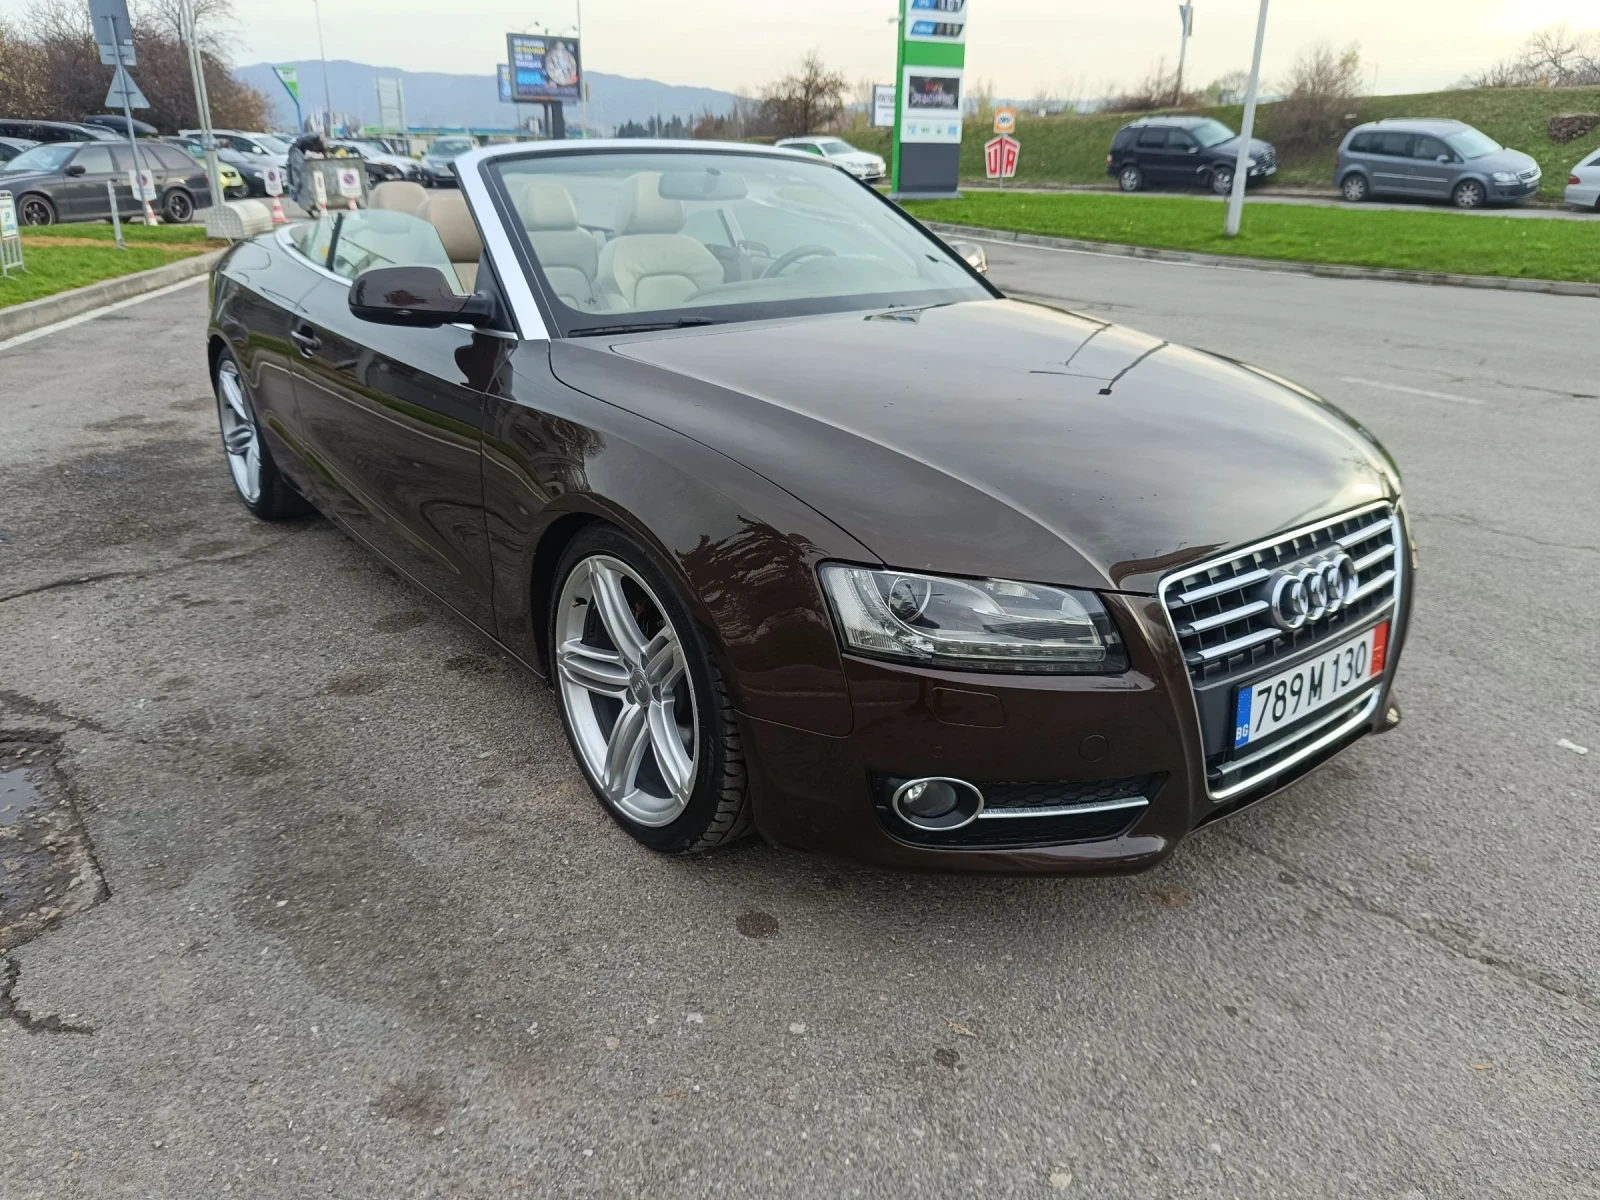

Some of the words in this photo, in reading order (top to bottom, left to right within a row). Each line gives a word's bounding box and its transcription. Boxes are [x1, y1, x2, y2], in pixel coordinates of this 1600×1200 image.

[1255, 673, 1304, 732] 789
[1307, 661, 1325, 706] M
[1332, 641, 1367, 692] 130
[1236, 723, 1249, 740] BG
